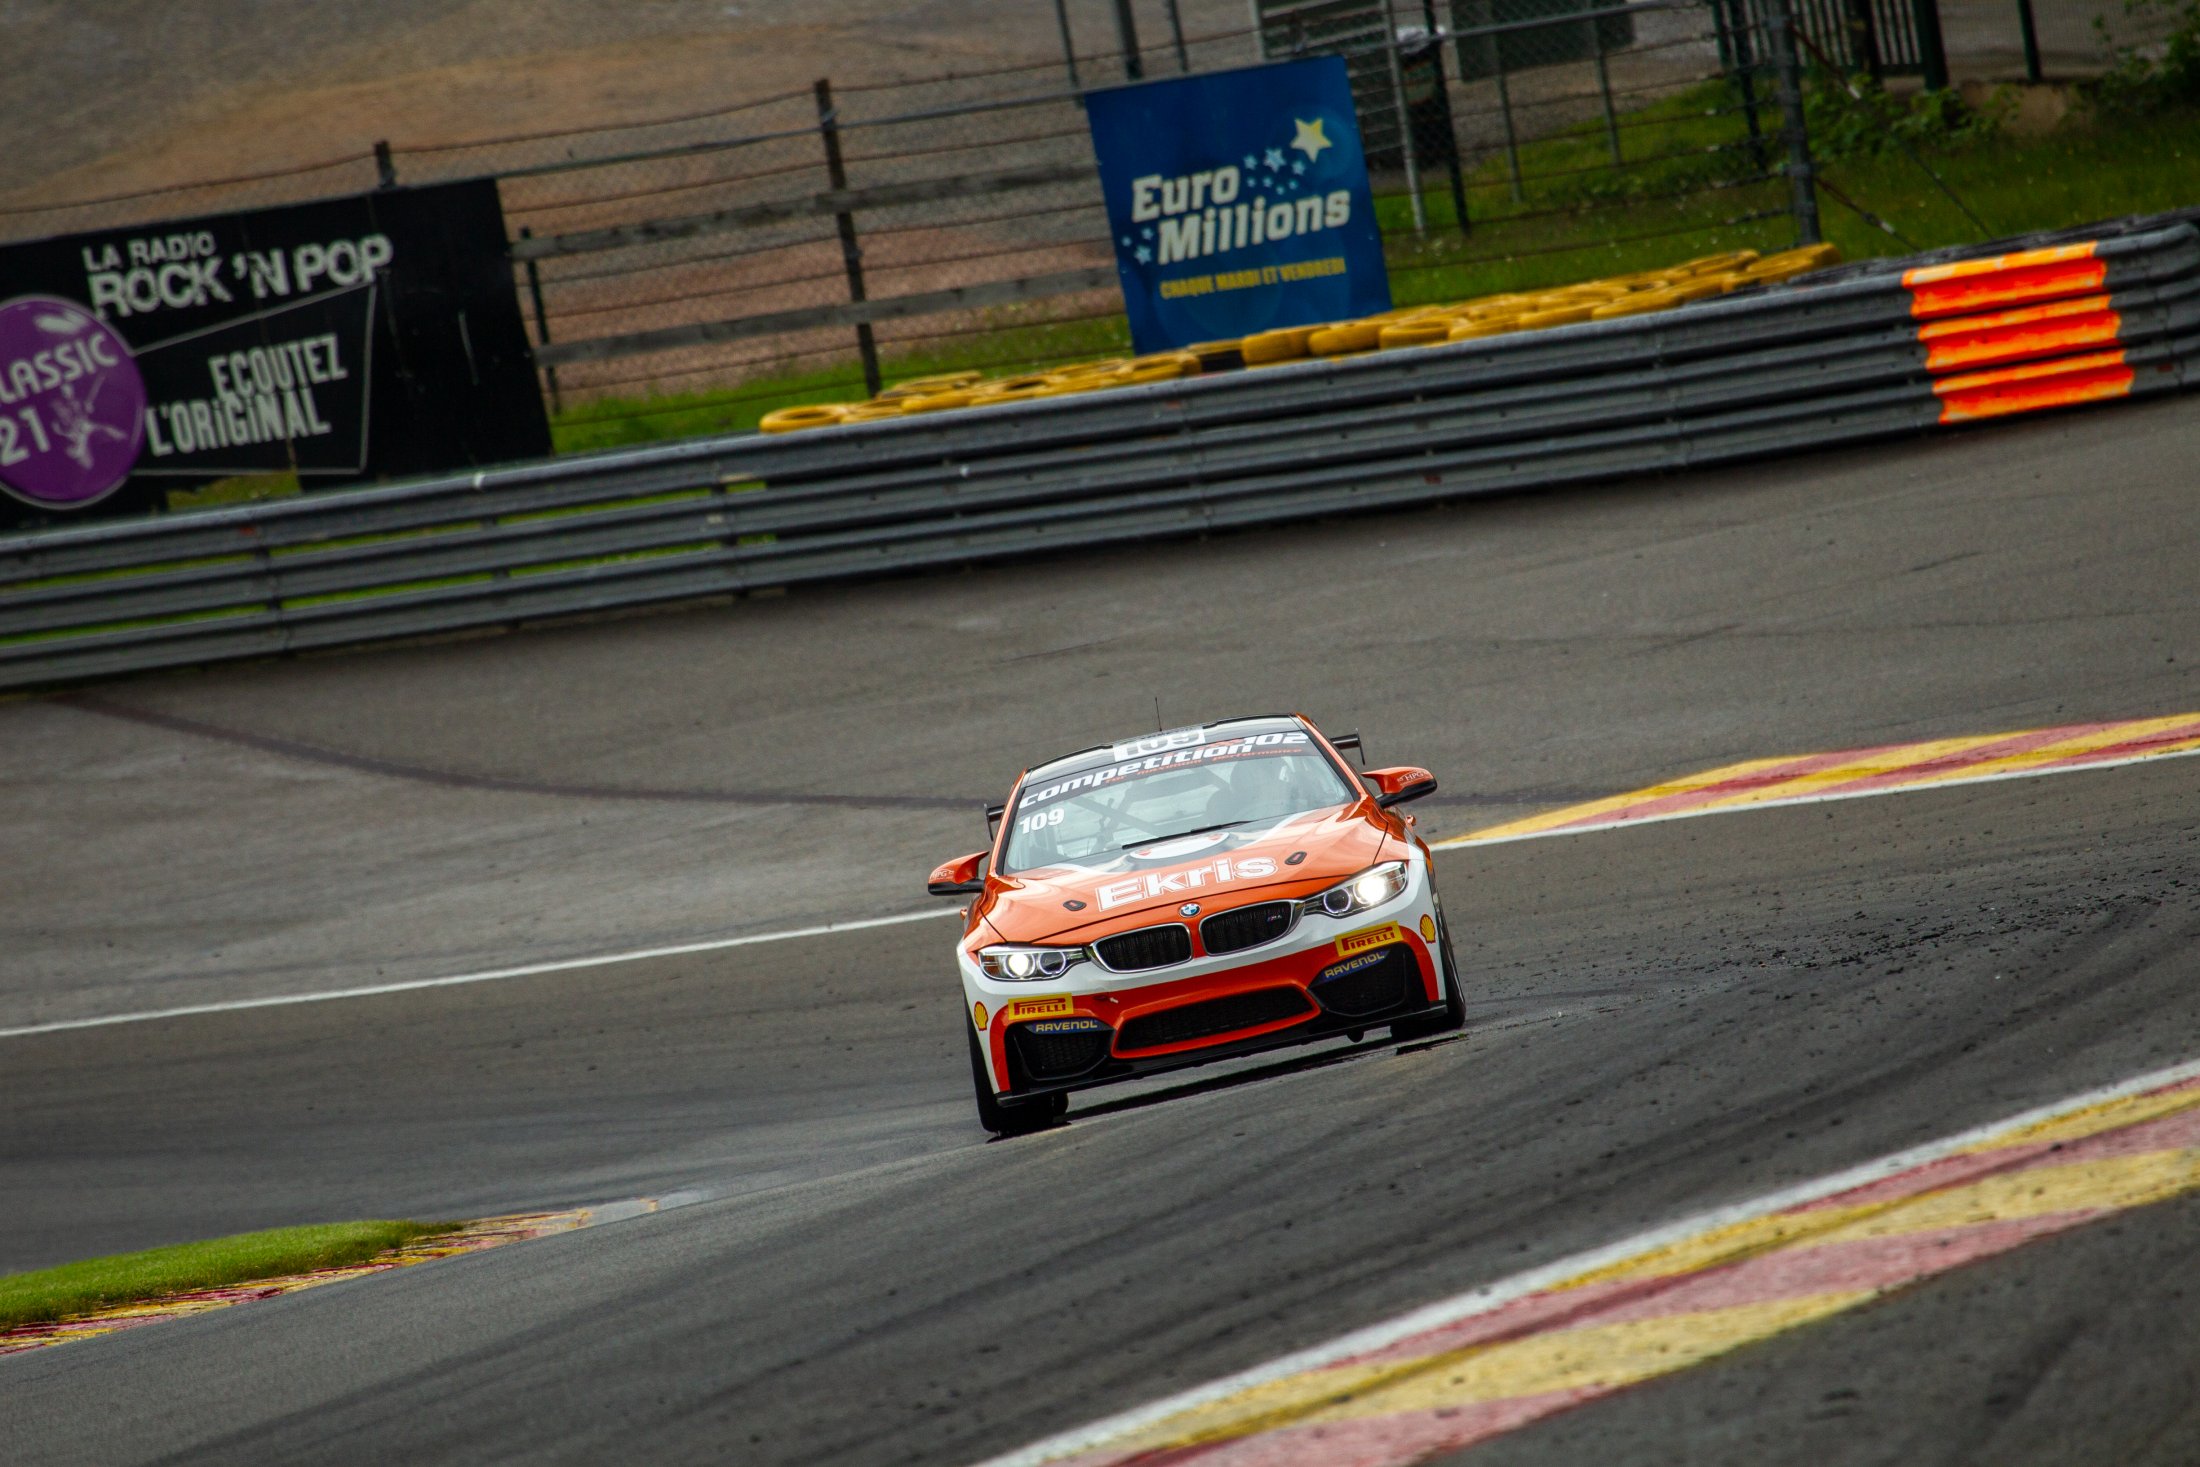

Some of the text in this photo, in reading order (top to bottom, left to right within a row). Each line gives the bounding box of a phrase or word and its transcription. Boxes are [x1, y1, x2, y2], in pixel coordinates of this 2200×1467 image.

[1131, 165, 1240, 223] Euro
[82, 231, 217, 272] LA RADIO
[1157, 189, 1350, 265] Millions
[87, 254, 233, 322] ROCK
[293, 233, 394, 292] POP
[1160, 256, 1347, 299] CHAQUE MARDI ET VENDREDI
[0, 331, 119, 404] LASSIC
[208, 332, 348, 399] ECOUTEZ
[0, 406, 51, 467] 21
[1019, 732, 1309, 809] competition 102
[1020, 808, 1065, 834] 109
[1096, 857, 1279, 912] Ekris
[1324, 951, 1385, 978] RAVENOL
[1341, 926, 1396, 951] PIRELLI
[1014, 998, 1066, 1015] PIRELLI
[1035, 1020, 1097, 1032] RAVENOL
